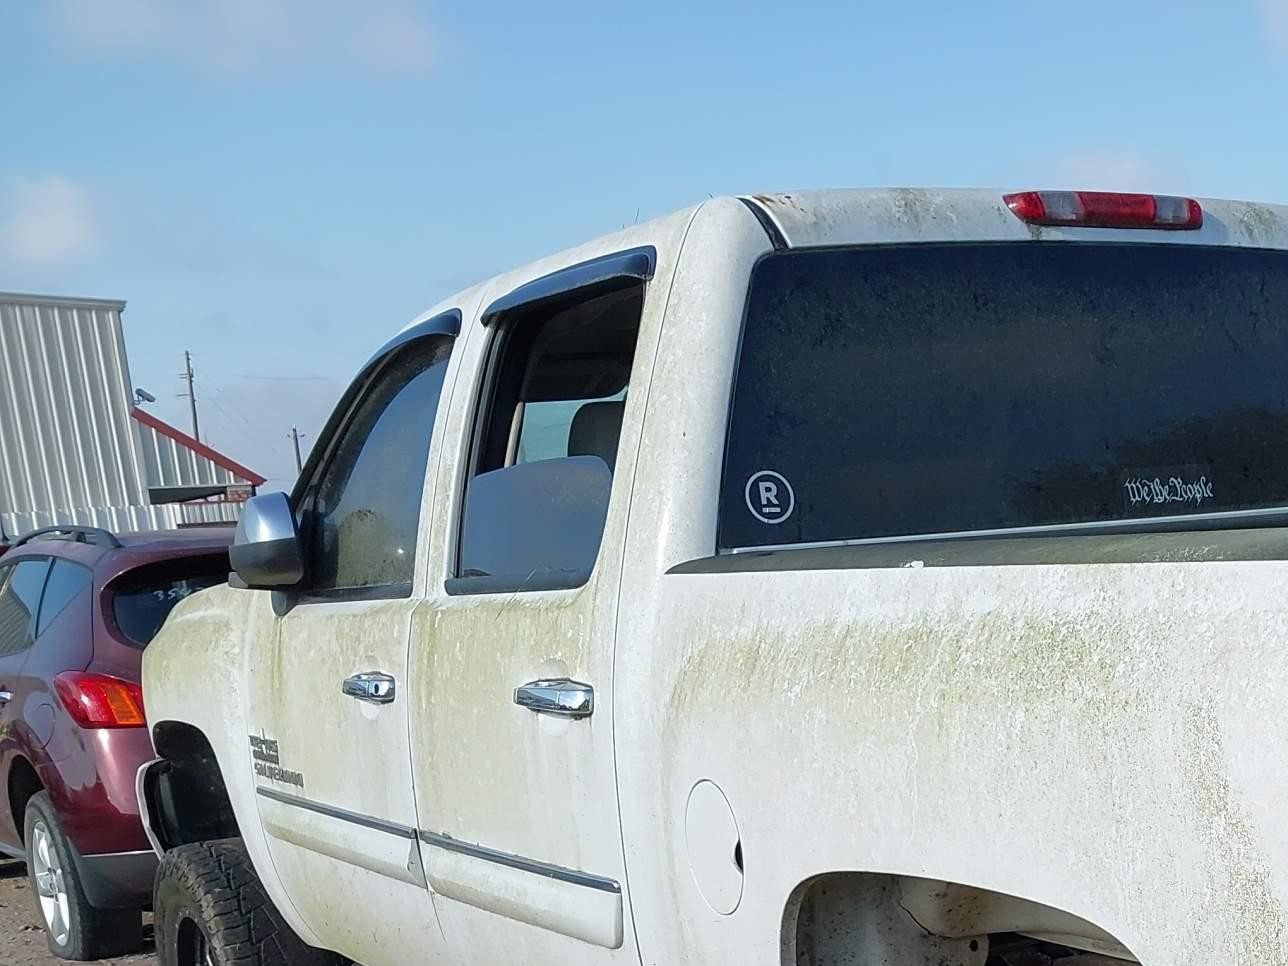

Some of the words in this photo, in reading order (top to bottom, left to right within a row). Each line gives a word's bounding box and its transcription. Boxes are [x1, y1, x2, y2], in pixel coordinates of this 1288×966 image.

[1124, 477, 1152, 506] We
[1142, 478, 1171, 504] the
[1168, 476, 1214, 507] People
